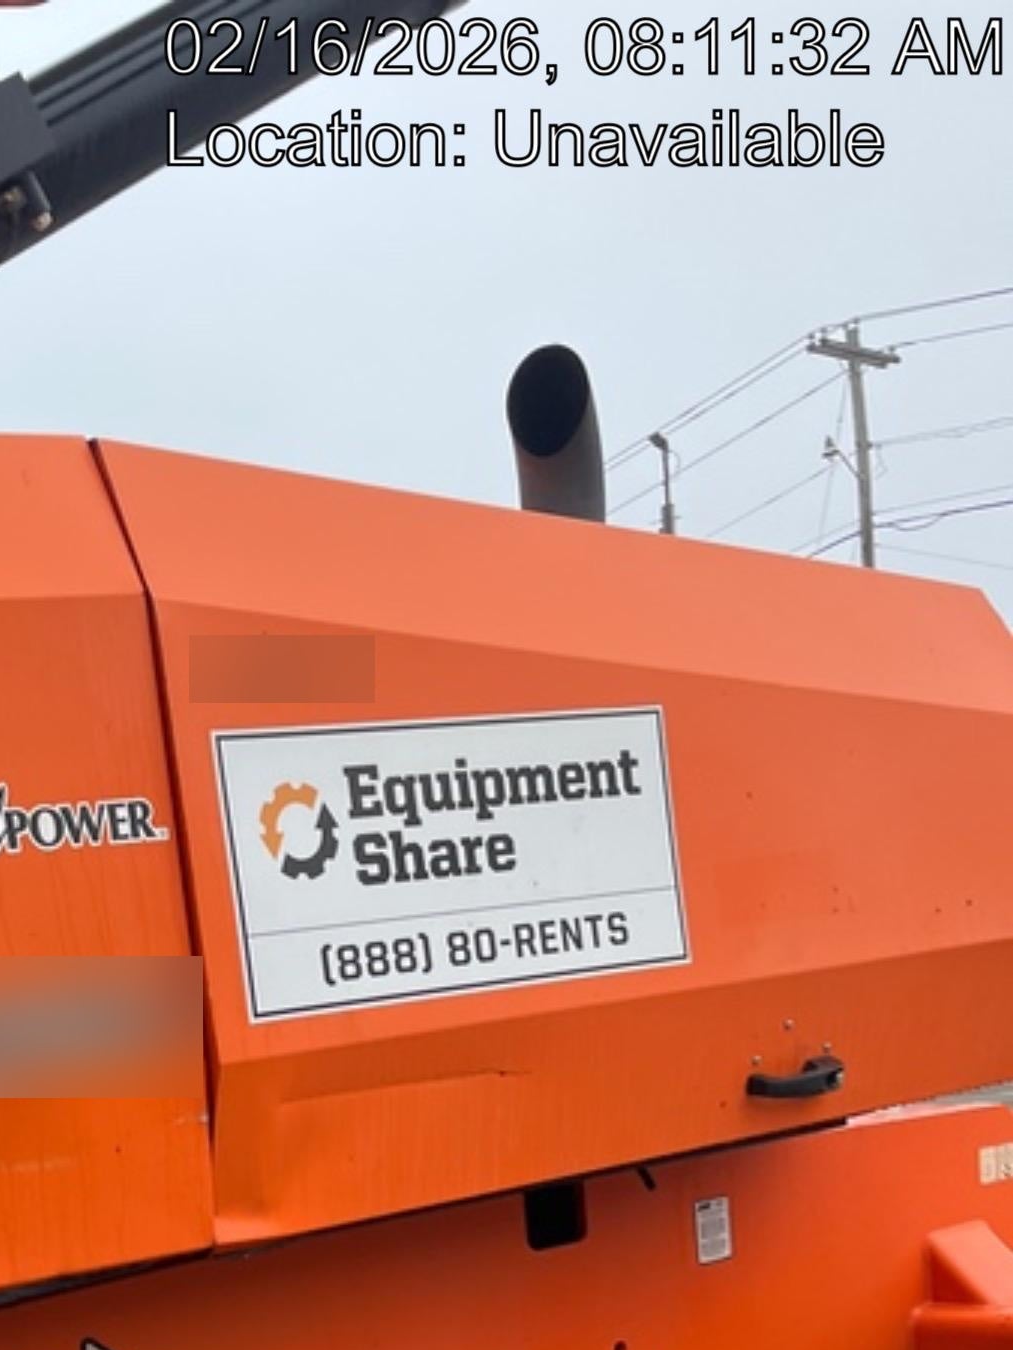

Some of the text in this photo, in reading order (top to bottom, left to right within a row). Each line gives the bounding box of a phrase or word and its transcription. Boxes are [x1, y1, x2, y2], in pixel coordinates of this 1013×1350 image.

[343, 750, 641, 826] Equipment
[3, 799, 158, 850] POWER
[352, 829, 517, 886] Share
[321, 911, 630, 986] (888) 80-RENTS
